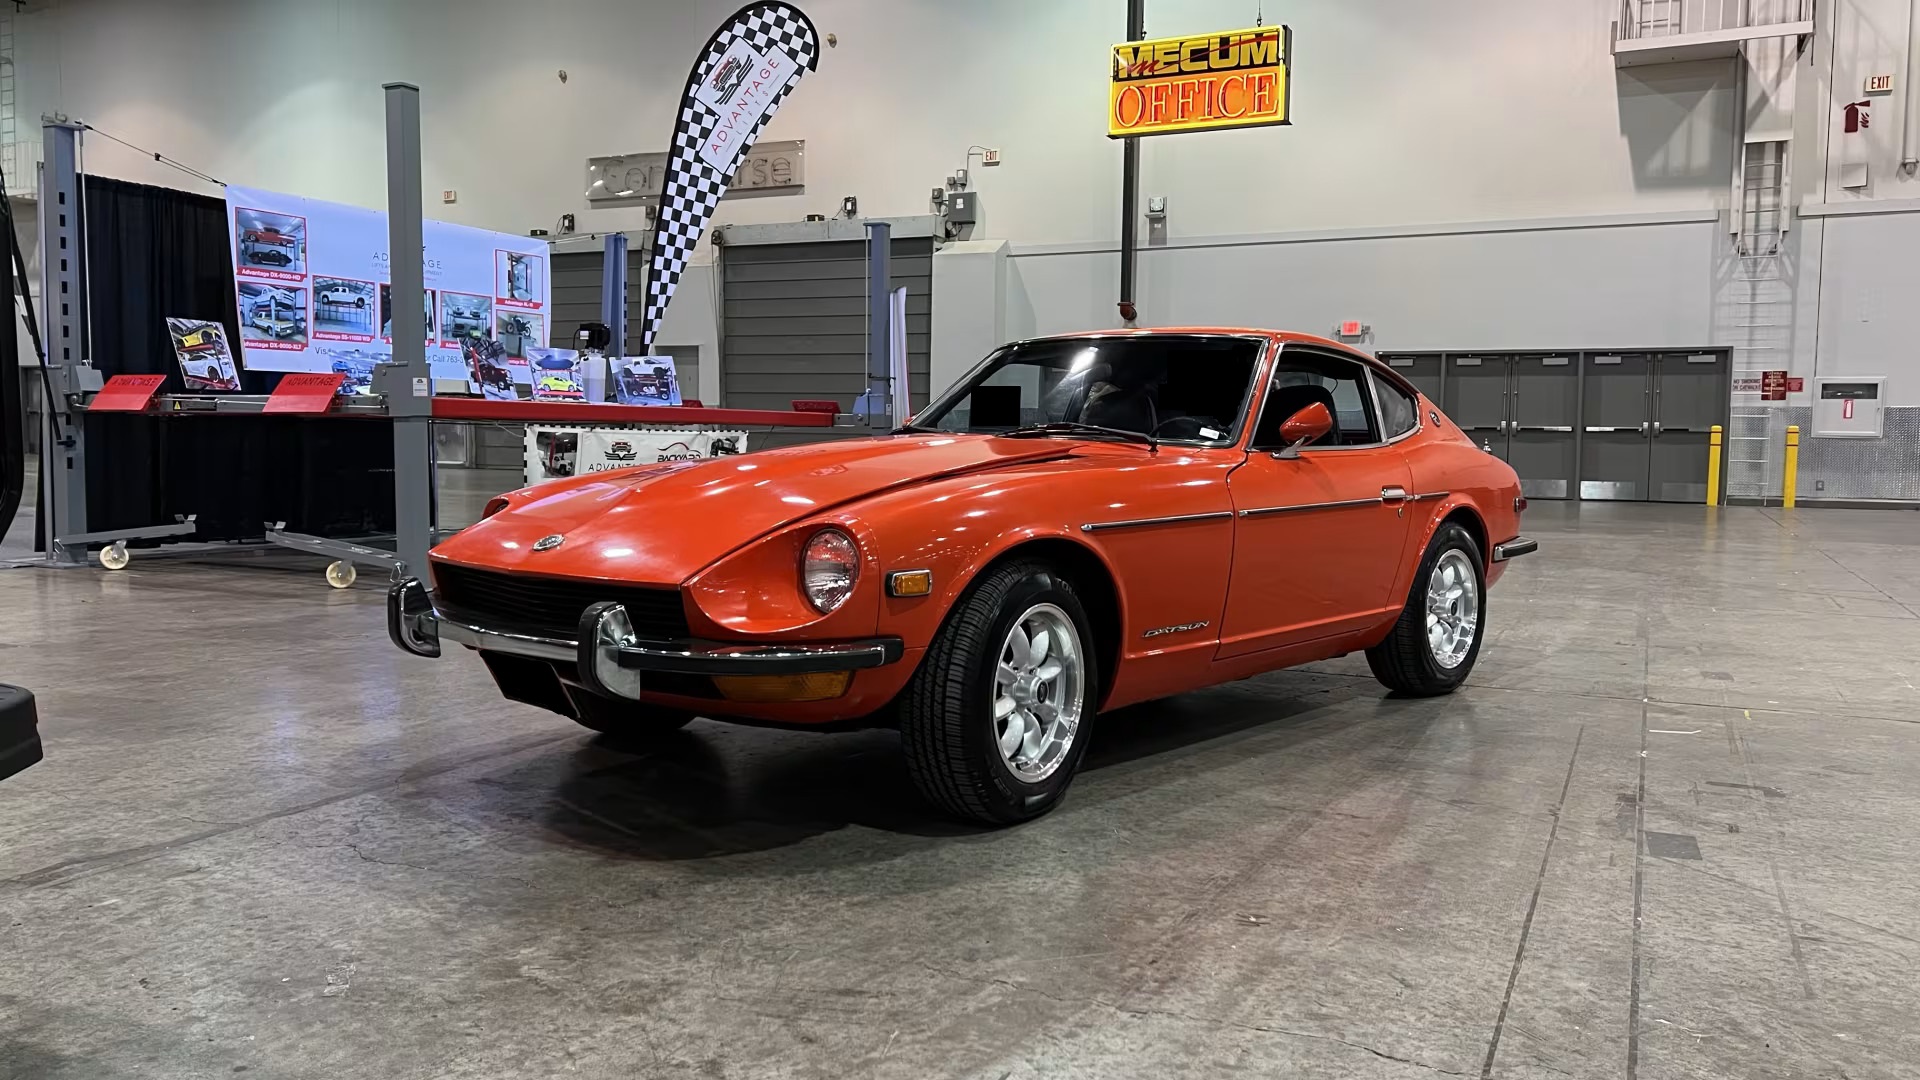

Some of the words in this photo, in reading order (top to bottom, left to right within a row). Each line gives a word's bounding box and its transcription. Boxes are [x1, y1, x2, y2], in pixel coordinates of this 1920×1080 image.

[1118, 32, 1279, 79] MECUM
[1871, 75, 1891, 89] EXIT
[711, 58, 780, 155] ADVANTAGE
[1115, 72, 1279, 127] OFFICE
[736, 90, 769, 136] LIFTS
[985, 150, 998, 161] EXIT
[432, 354, 445, 363] Call
[285, 376, 337, 386] ADVANTAGE
[1142, 620, 1210, 638] DATSUN
